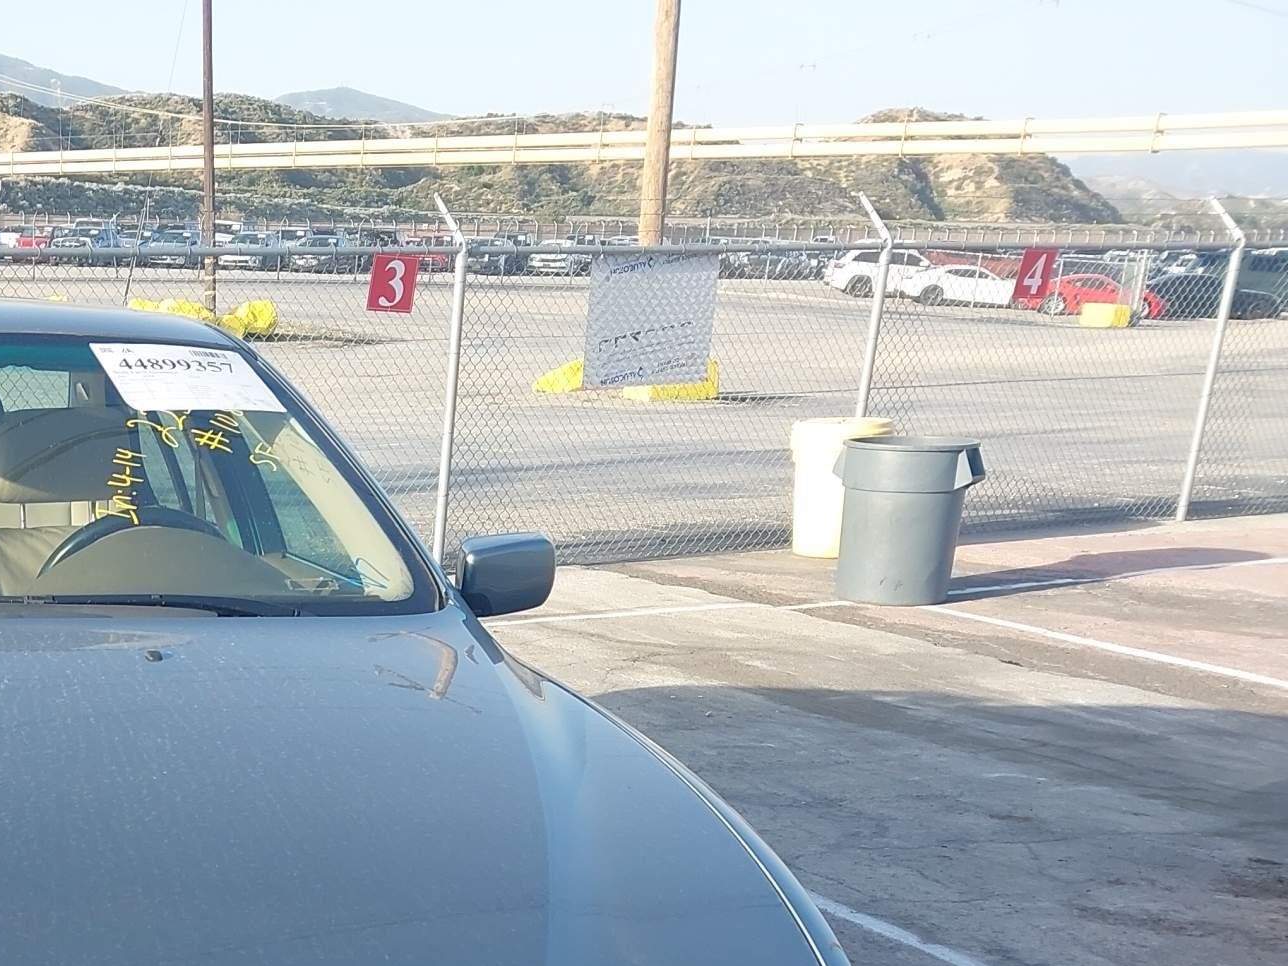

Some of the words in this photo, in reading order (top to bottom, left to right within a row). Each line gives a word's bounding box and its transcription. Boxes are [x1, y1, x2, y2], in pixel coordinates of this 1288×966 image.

[378, 259, 406, 307] 3
[1023, 253, 1049, 295] 4
[119, 357, 234, 374] 44899357
